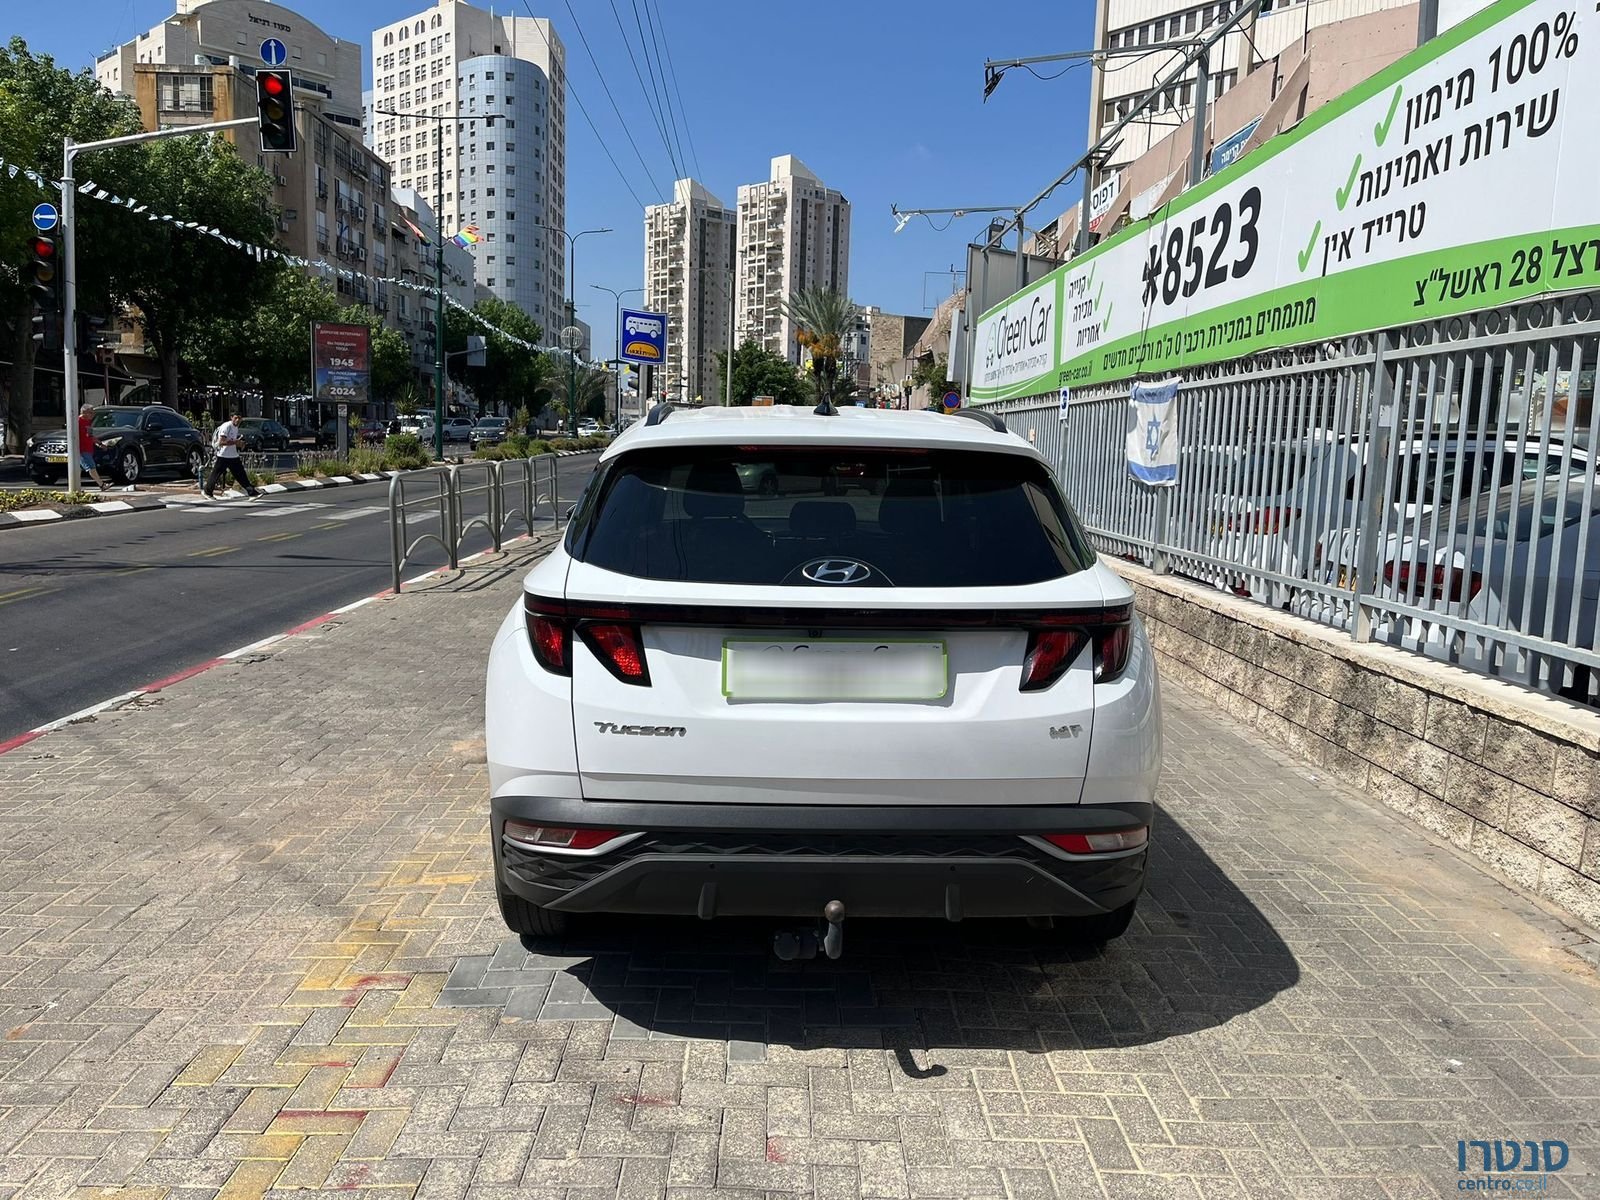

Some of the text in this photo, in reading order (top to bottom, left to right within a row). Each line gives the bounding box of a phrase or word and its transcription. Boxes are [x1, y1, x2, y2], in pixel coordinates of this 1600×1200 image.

[1404, 11, 1579, 145] 100% מימון
[1356, 88, 1560, 208] שירות ואמינות
[1092, 181, 1115, 210] דפוס
[1321, 201, 1427, 277] טרייד אין
[1508, 245, 1543, 288] 28
[1068, 275, 1087, 300] קנייה
[1072, 299, 1093, 323] מכירה
[1255, 296, 1317, 336] מתמחים
[997, 296, 1052, 360] Green Car
[1076, 322, 1102, 348] אחריות
[1183, 329, 1205, 354] רכבי
[1206, 315, 1252, 349] במכירת
[330, 357, 354, 367] 1945
[1102, 349, 1127, 370] חדשים
[330, 386, 356, 396] 2024
